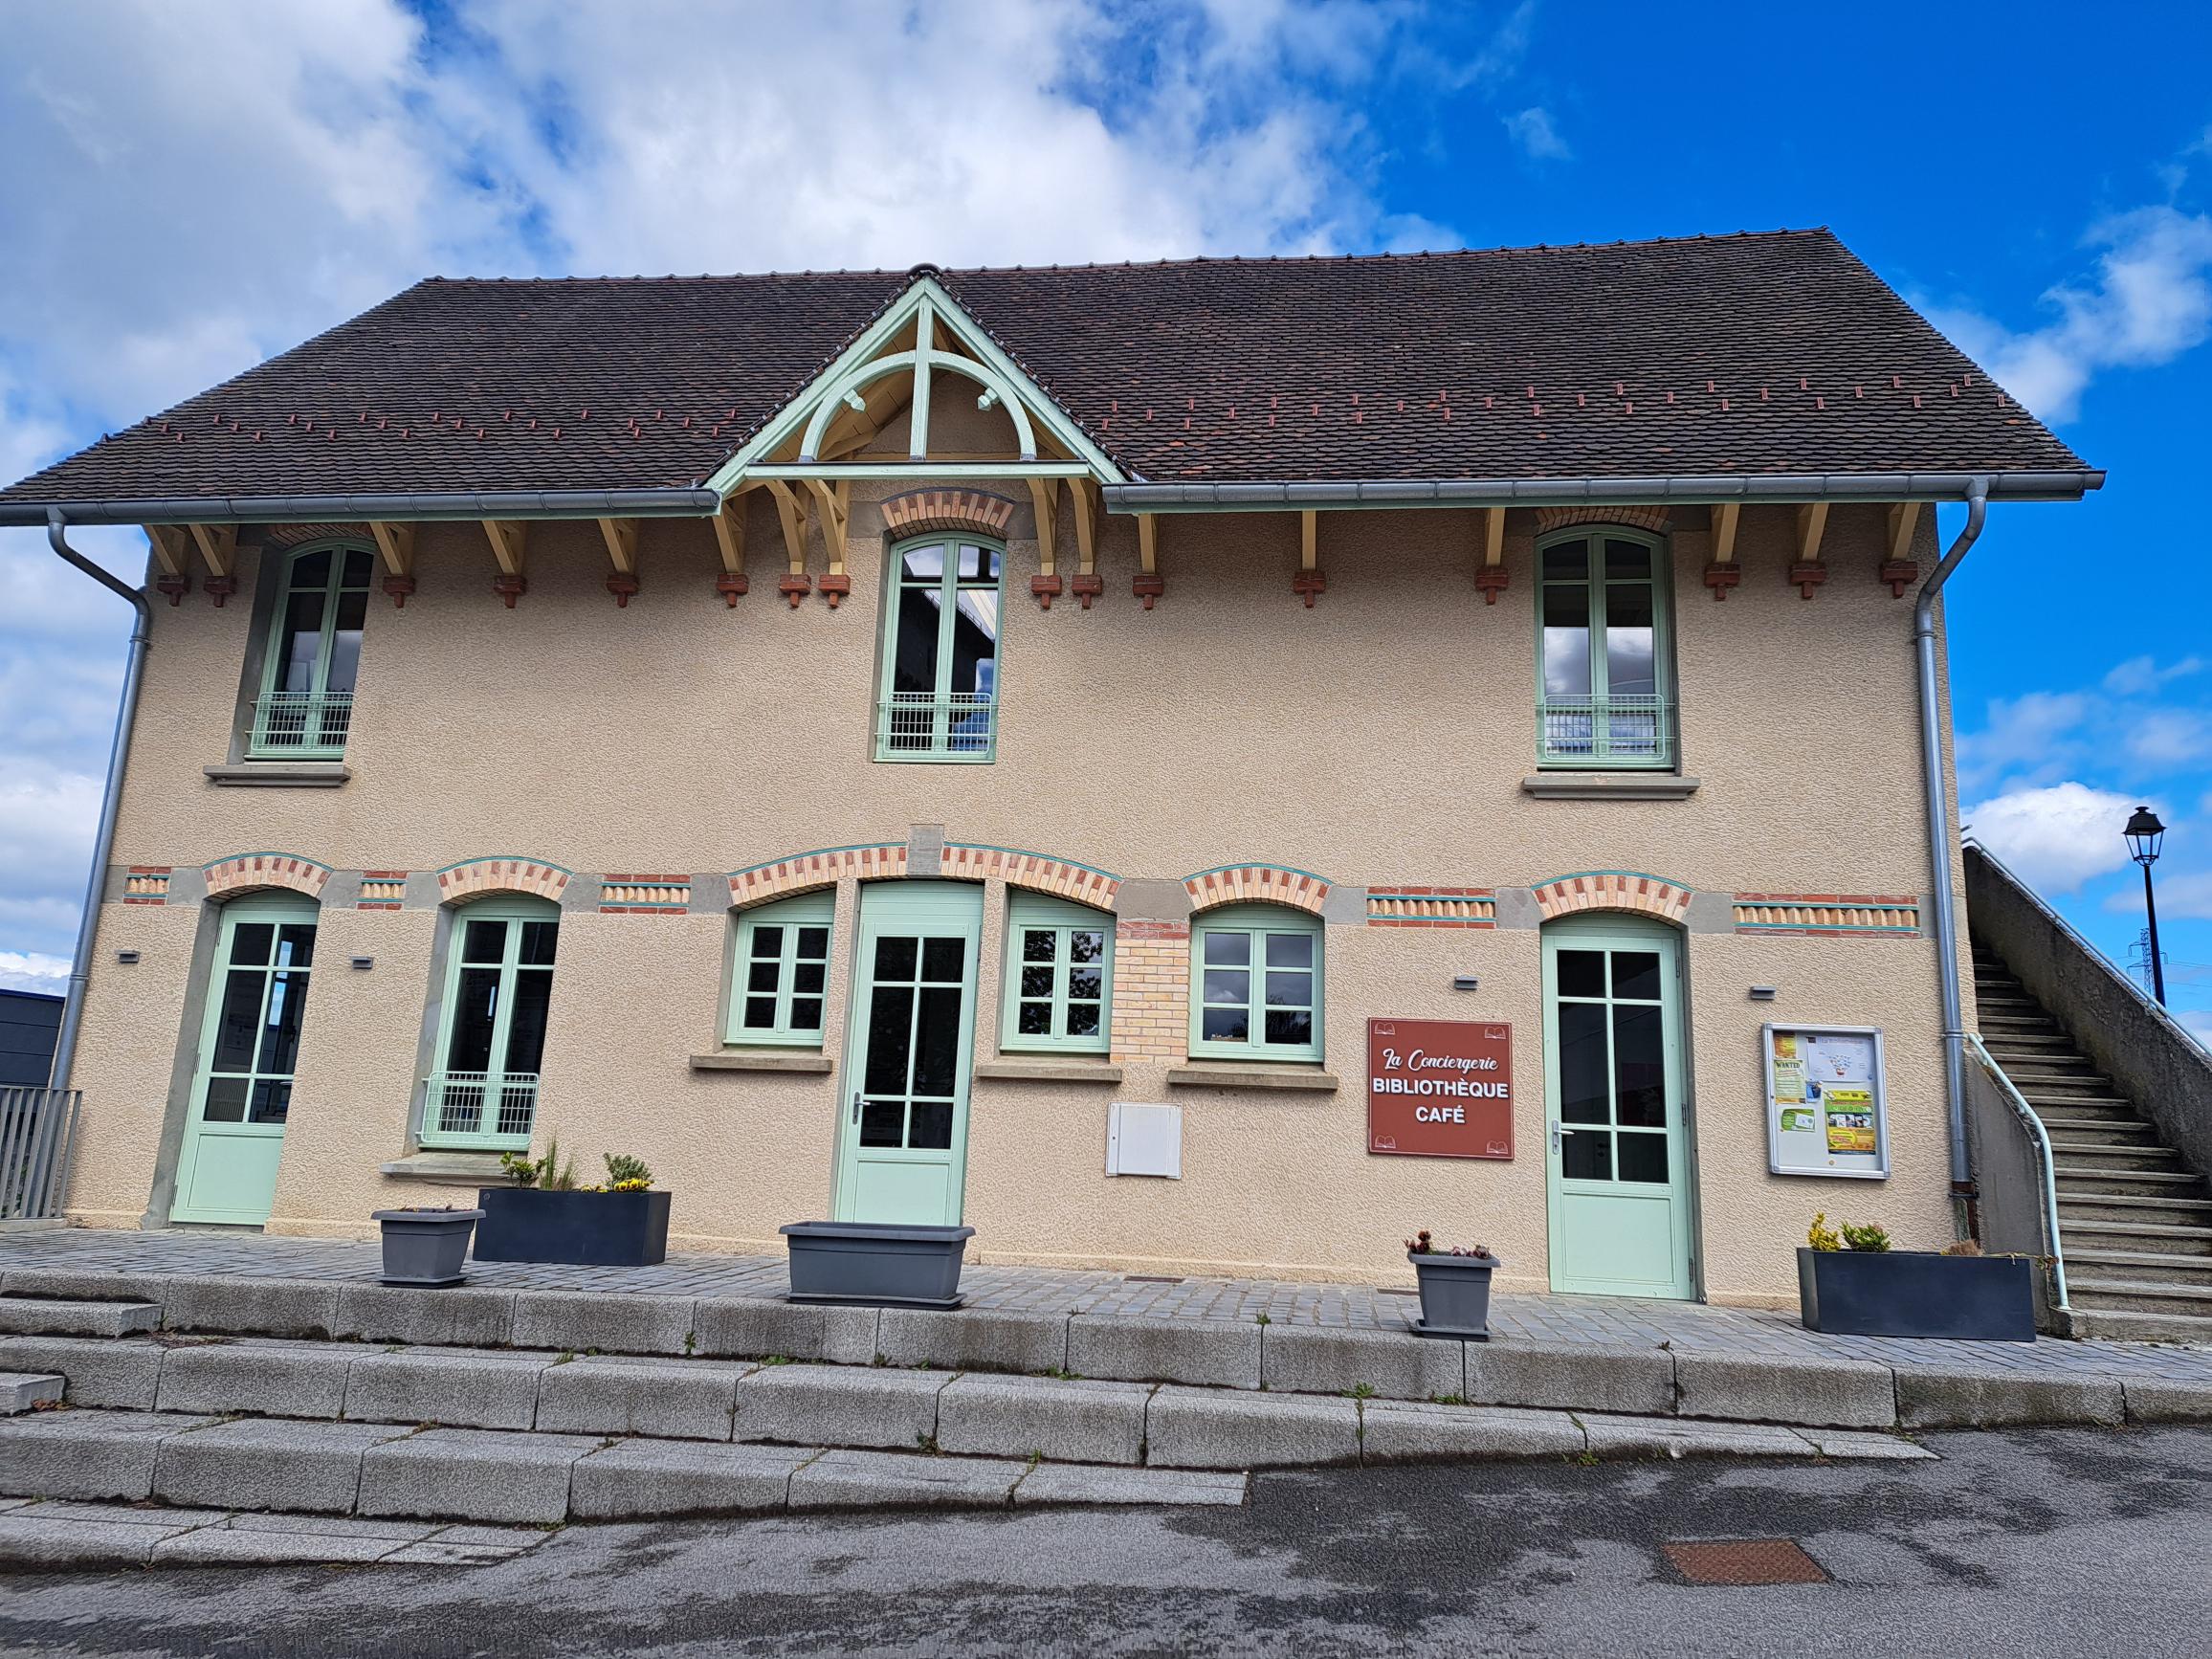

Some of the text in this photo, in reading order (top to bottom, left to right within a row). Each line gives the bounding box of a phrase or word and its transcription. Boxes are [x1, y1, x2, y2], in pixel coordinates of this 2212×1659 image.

[1382, 1048, 1499, 1074] La Conciergerie
[1372, 1076, 1510, 1099] BIBLIOTHÈQUE
[1415, 1104, 1466, 1124] CAFÉ
